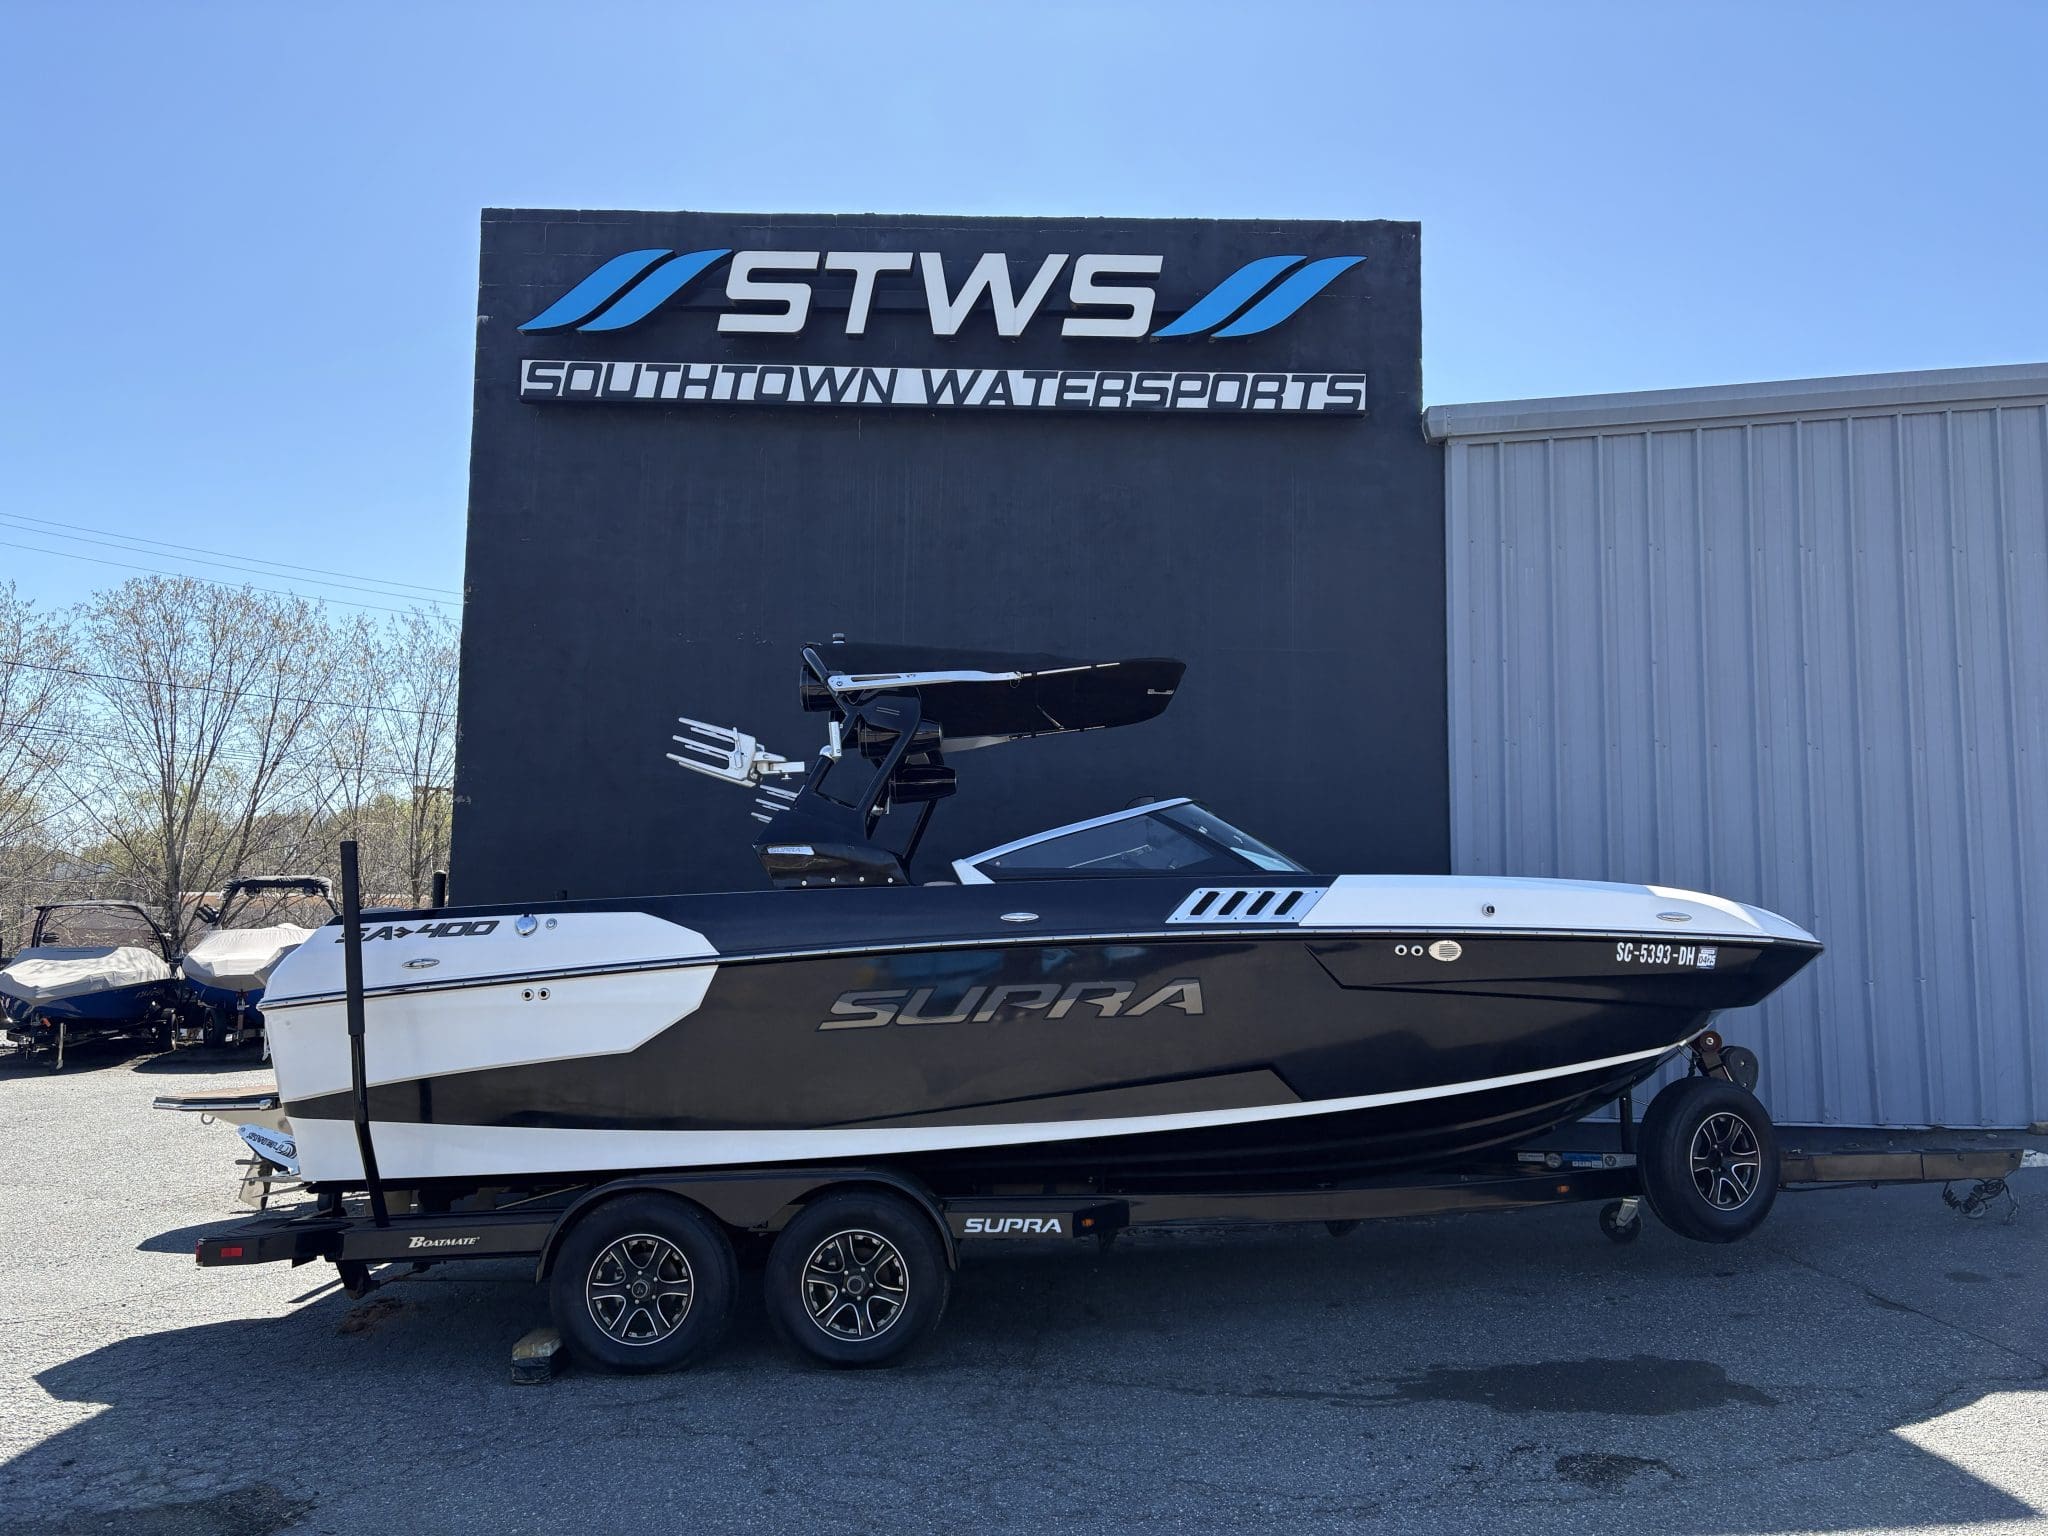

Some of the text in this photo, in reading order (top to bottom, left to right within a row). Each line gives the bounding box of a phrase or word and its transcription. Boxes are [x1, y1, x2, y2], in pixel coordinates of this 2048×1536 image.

[717, 250, 1164, 338] STWS
[525, 361, 1368, 412] SOUTHTOWN WATERSPORTS
[1616, 942, 1695, 966] SC-5393-DH
[816, 977, 1204, 1032] SUPRA
[963, 1218, 1062, 1233] SUPRA
